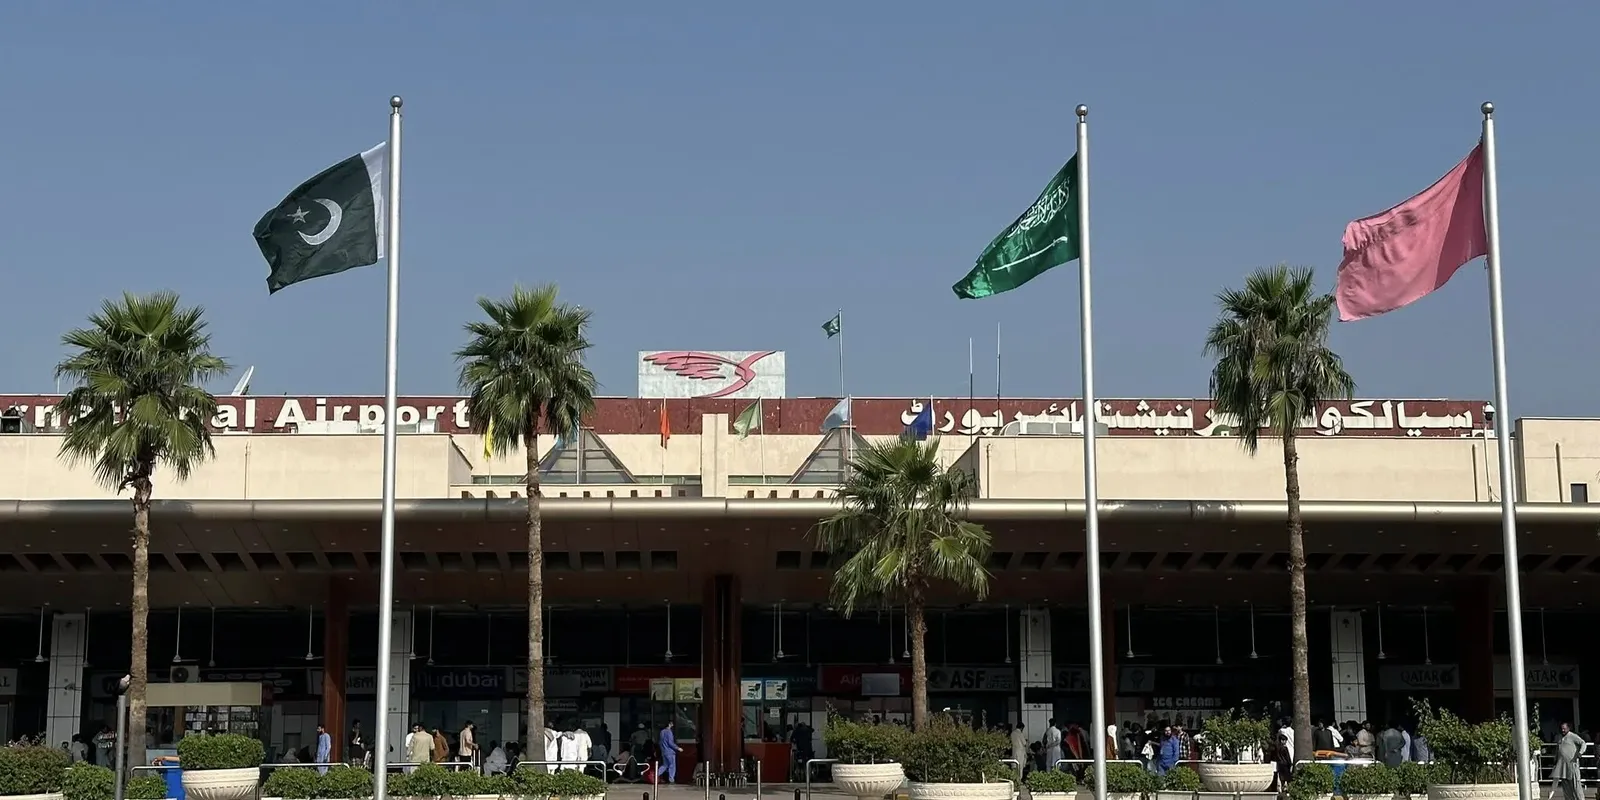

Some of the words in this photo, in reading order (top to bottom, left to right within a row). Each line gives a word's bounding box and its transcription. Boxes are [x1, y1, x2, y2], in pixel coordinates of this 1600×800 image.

[274, 398, 470, 428] Airport
[950, 669, 985, 689] ASF
[1401, 670, 1440, 683] QATAR
[1526, 669, 1557, 682] ATAR
